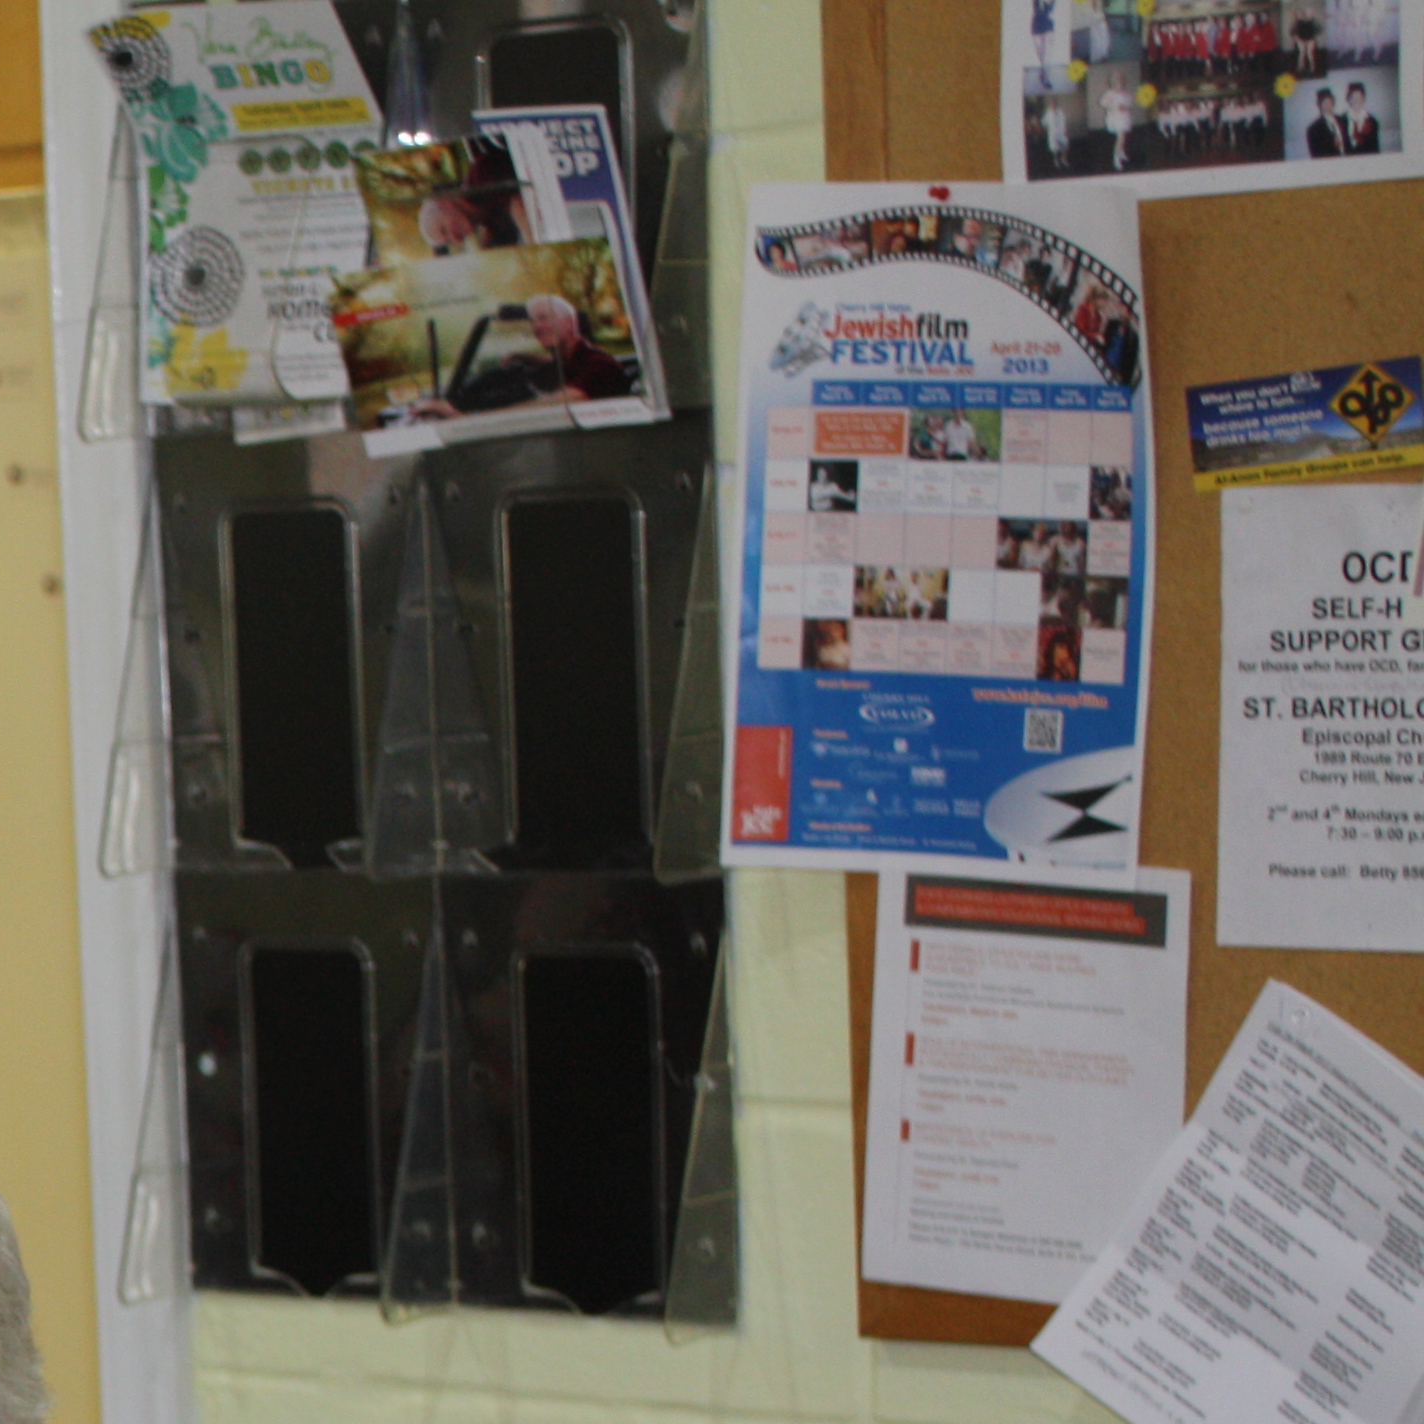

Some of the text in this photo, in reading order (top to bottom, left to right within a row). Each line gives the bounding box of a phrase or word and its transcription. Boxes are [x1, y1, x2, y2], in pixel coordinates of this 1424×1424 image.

[210, 59, 333, 89] BINGO
[830, 340, 974, 365] FESTIVAL
[1002, 357, 1050, 374] 2013
[1203, 409, 1324, 434] because someone
[1312, 597, 1402, 619] SELF-H
[1270, 629, 1393, 652] SUPPORT
[1238, 659, 1256, 672] for
[1261, 659, 1298, 672] those
[1303, 660, 1332, 672] who
[1334, 659, 1365, 672] have
[1243, 697, 1283, 720] ST.
[1302, 728, 1392, 748] Episcopal
[1351, 751, 1392, 765] Route
[1397, 751, 1414, 765] 70
[1299, 769, 1348, 786] Cherry
[1384, 771, 1415, 784] New
[1291, 808, 1319, 821] and
[1344, 808, 1409, 823] Mondays
[1326, 826, 1357, 840] 7:30
[1374, 826, 1404, 840] 9:00
[1269, 862, 1317, 878] Please
[1359, 863, 1398, 882] Betty
